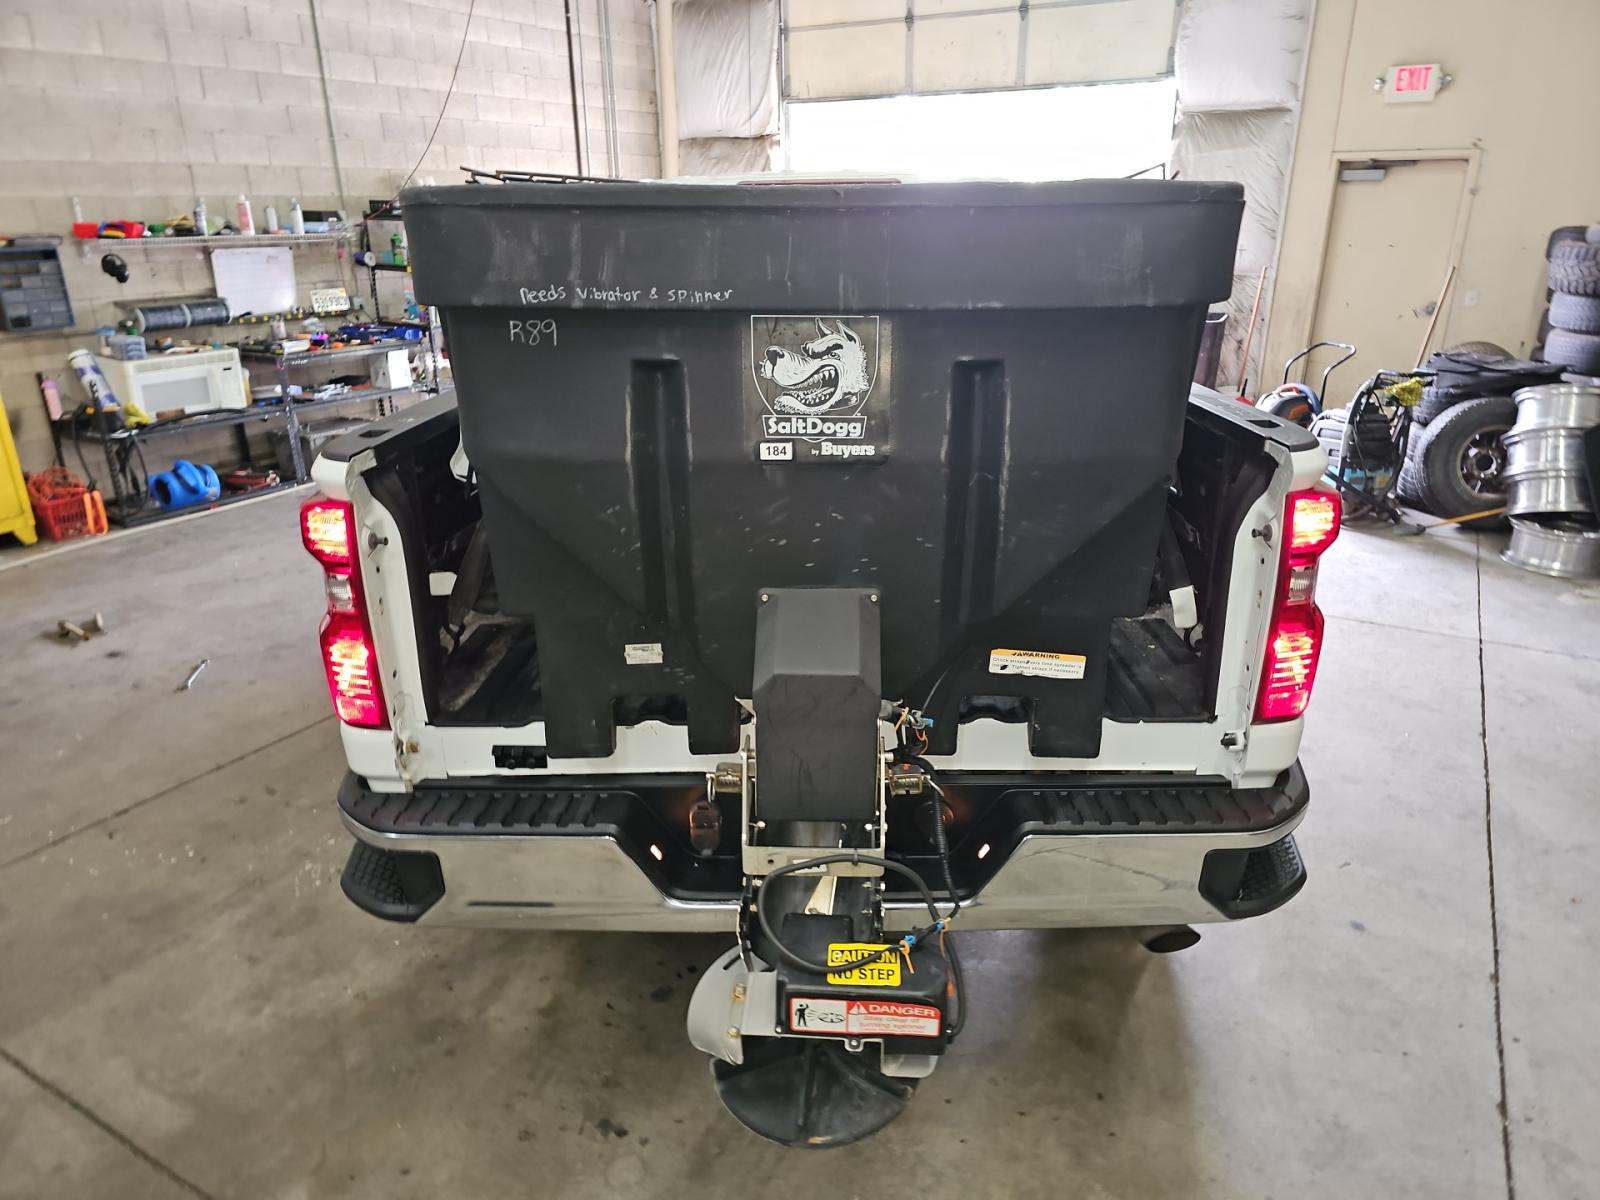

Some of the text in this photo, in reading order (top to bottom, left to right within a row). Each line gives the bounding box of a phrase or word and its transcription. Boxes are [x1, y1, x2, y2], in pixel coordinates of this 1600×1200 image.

[1396, 66, 1432, 92] EXIT
[648, 286, 659, 300] &
[508, 319, 558, 347] R89
[767, 416, 862, 438] SaltDogg
[765, 445, 787, 457] 184
[811, 441, 876, 459] by Buyers
[1022, 651, 1060, 659] WARNING
[859, 967, 895, 980] STEP
[868, 1004, 936, 1017] DANGER
